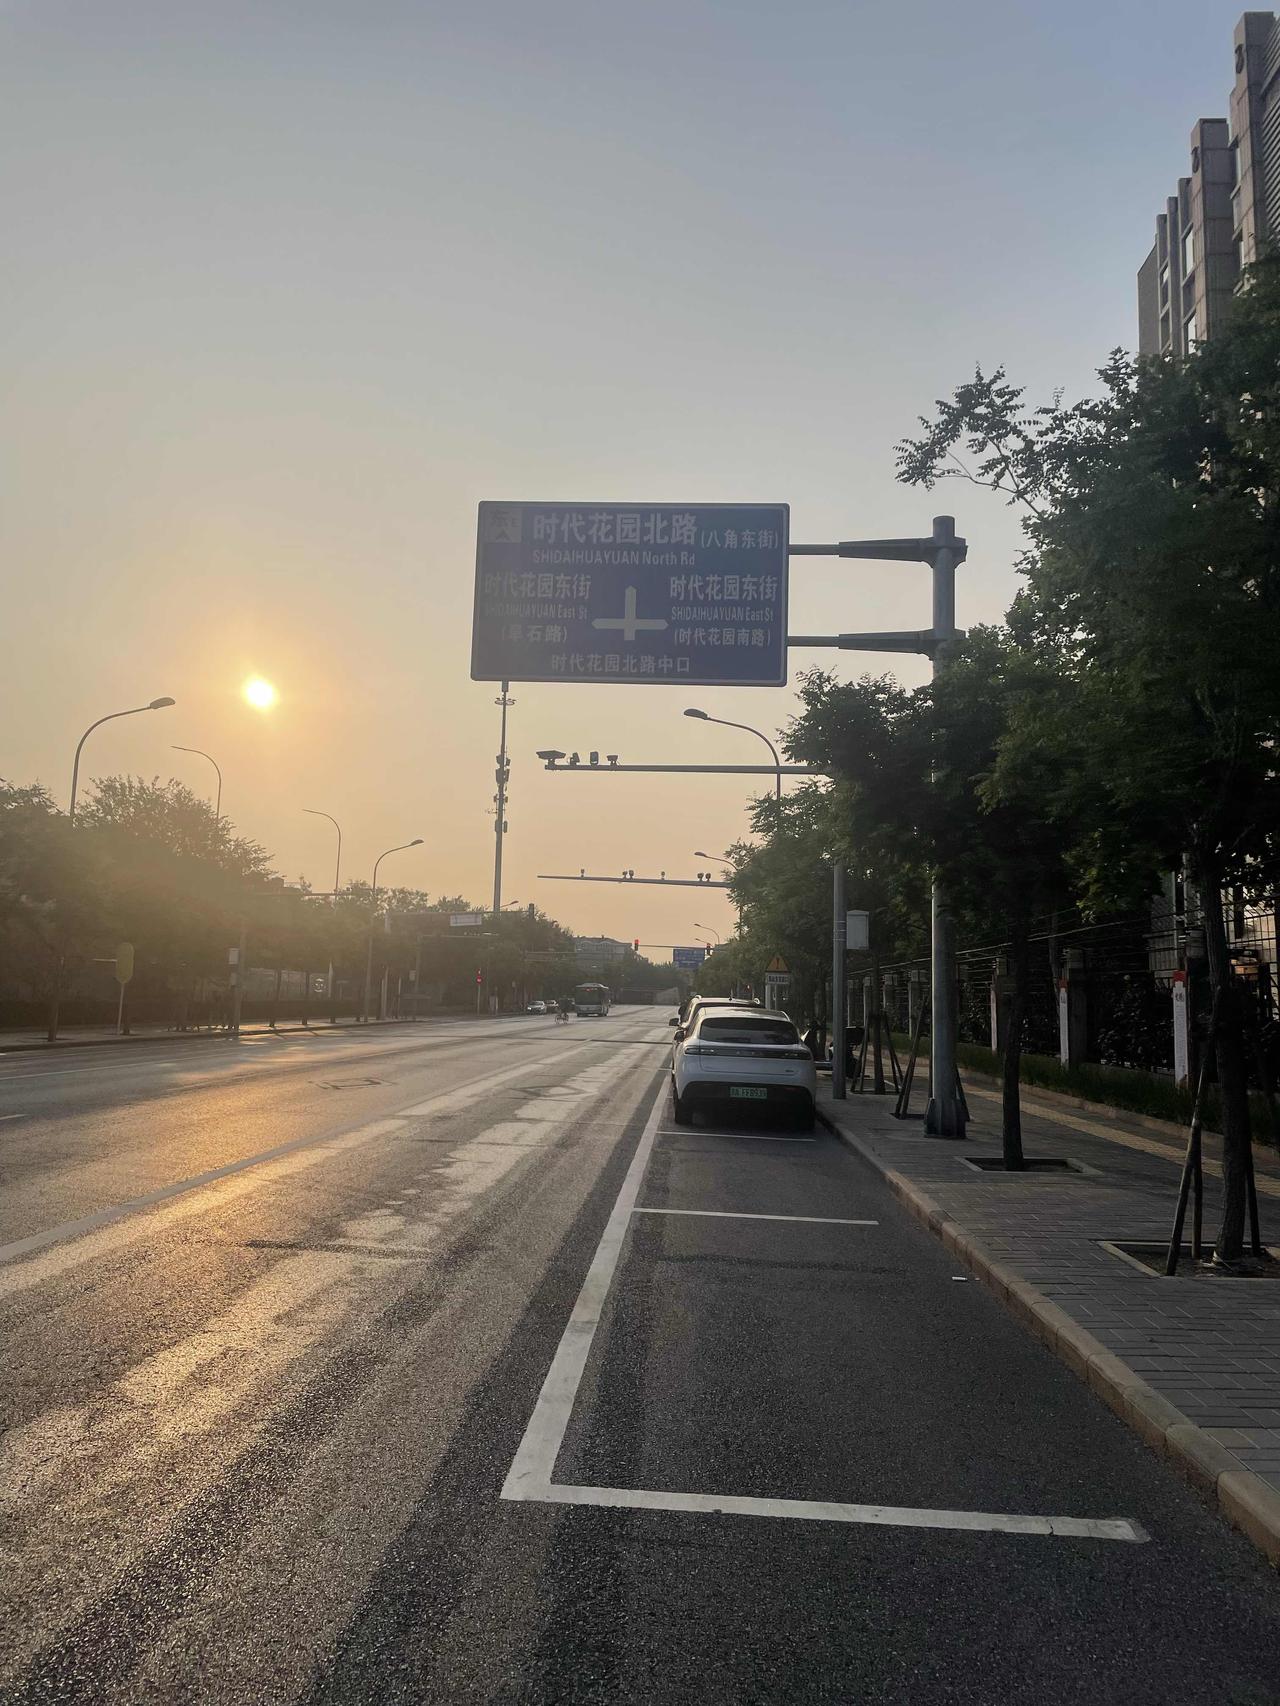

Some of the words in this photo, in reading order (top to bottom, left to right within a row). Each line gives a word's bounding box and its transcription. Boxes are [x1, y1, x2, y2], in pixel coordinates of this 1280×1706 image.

[532, 512, 698, 545] 时代花园北路
[700, 529, 779, 550] (八角东街)
[532, 550, 639, 565] SHIDAIHUAYUAN
[642, 551, 677, 566] North
[680, 552, 696, 566] Rd
[484, 573, 592, 600] 时代花园东街
[669, 574, 779, 602] 时代花园东街
[671, 606, 744, 621] SHIDAIHUAYUAN
[673, 627, 771, 648] (时代花园南路)
[551, 653, 690, 675] 时代花园北路中口
